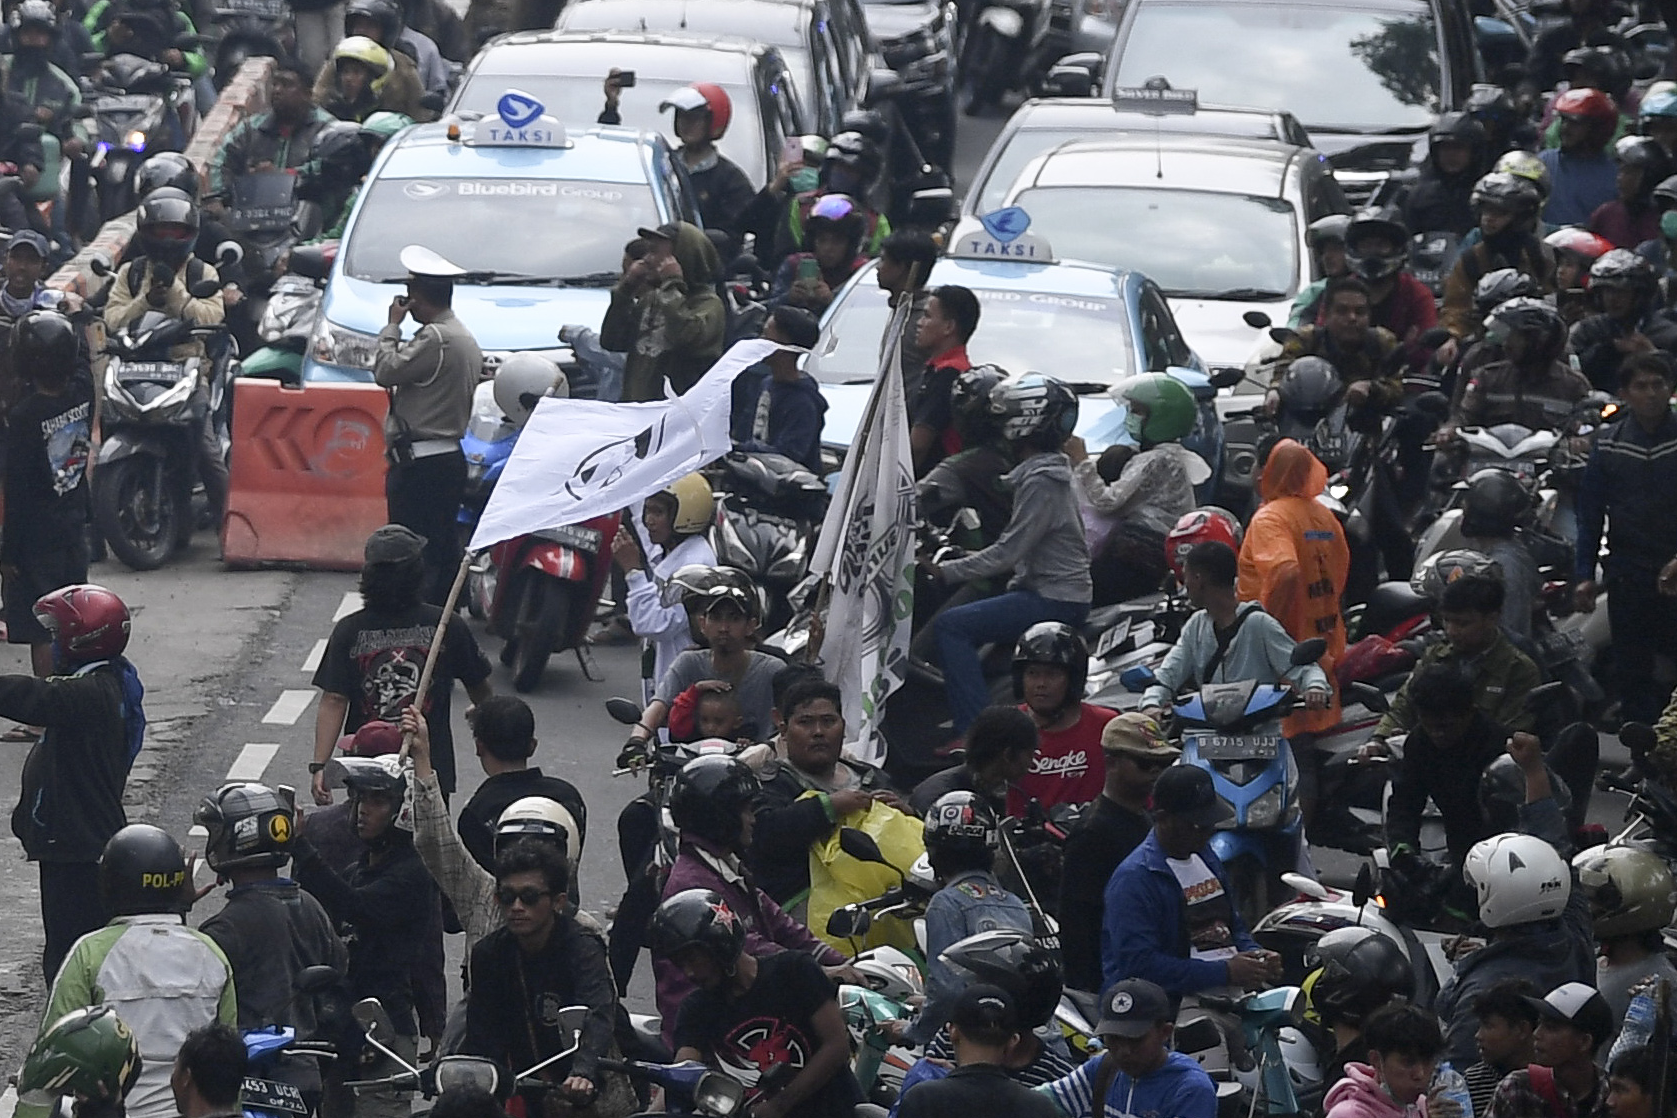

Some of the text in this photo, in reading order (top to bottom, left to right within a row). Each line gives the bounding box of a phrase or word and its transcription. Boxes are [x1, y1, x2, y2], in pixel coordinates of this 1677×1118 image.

[490, 129, 552, 142] TAKSI
[458, 182, 623, 200] Bluebird Group
[971, 241, 1035, 257] TAKSI
[1029, 293, 1107, 311] GROUP
